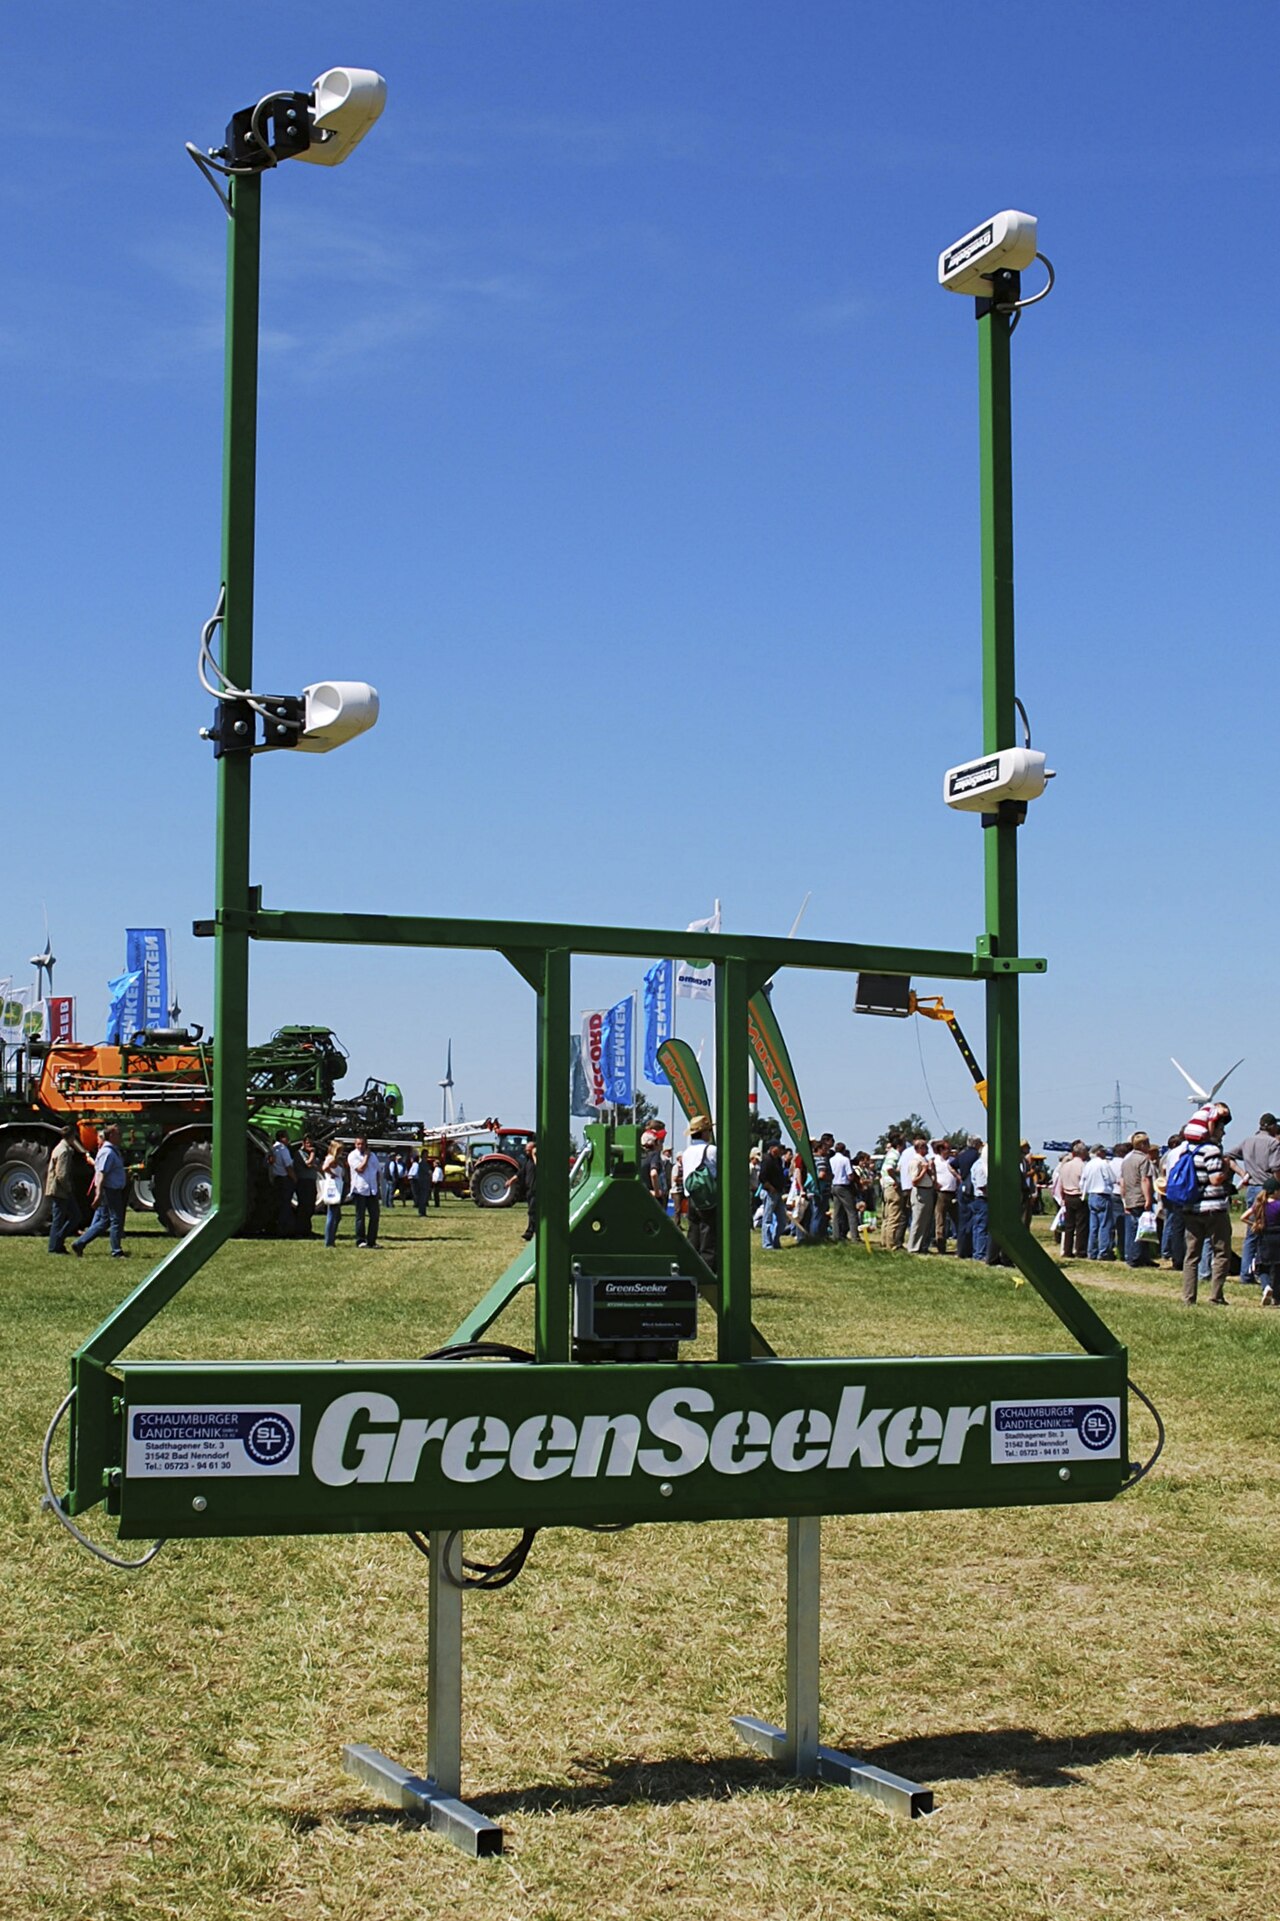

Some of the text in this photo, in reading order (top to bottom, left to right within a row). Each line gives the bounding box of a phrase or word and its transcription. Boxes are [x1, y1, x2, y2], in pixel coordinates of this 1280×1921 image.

[605, 1283, 668, 1292] GreenSeeker
[1000, 1406, 1074, 1418] SCHAUMBURGER
[140, 1414, 239, 1425] SCHAUMBURGER
[1000, 1419, 1062, 1430] LANDTECHNIK
[140, 1427, 222, 1439] LANDTECHNIK
[312, 1385, 987, 1487] GreenSeeker
[145, 1442, 201, 1451] Stadthagener
[1025, 1440, 1037, 1448] Bad
[1038, 1439, 1068, 1447] Nenndorf
[172, 1452, 189, 1460] Bad
[191, 1451, 230, 1460] Nenndorf
[164, 1462, 189, 1470] 05723
[221, 1461, 231, 1469] 30
